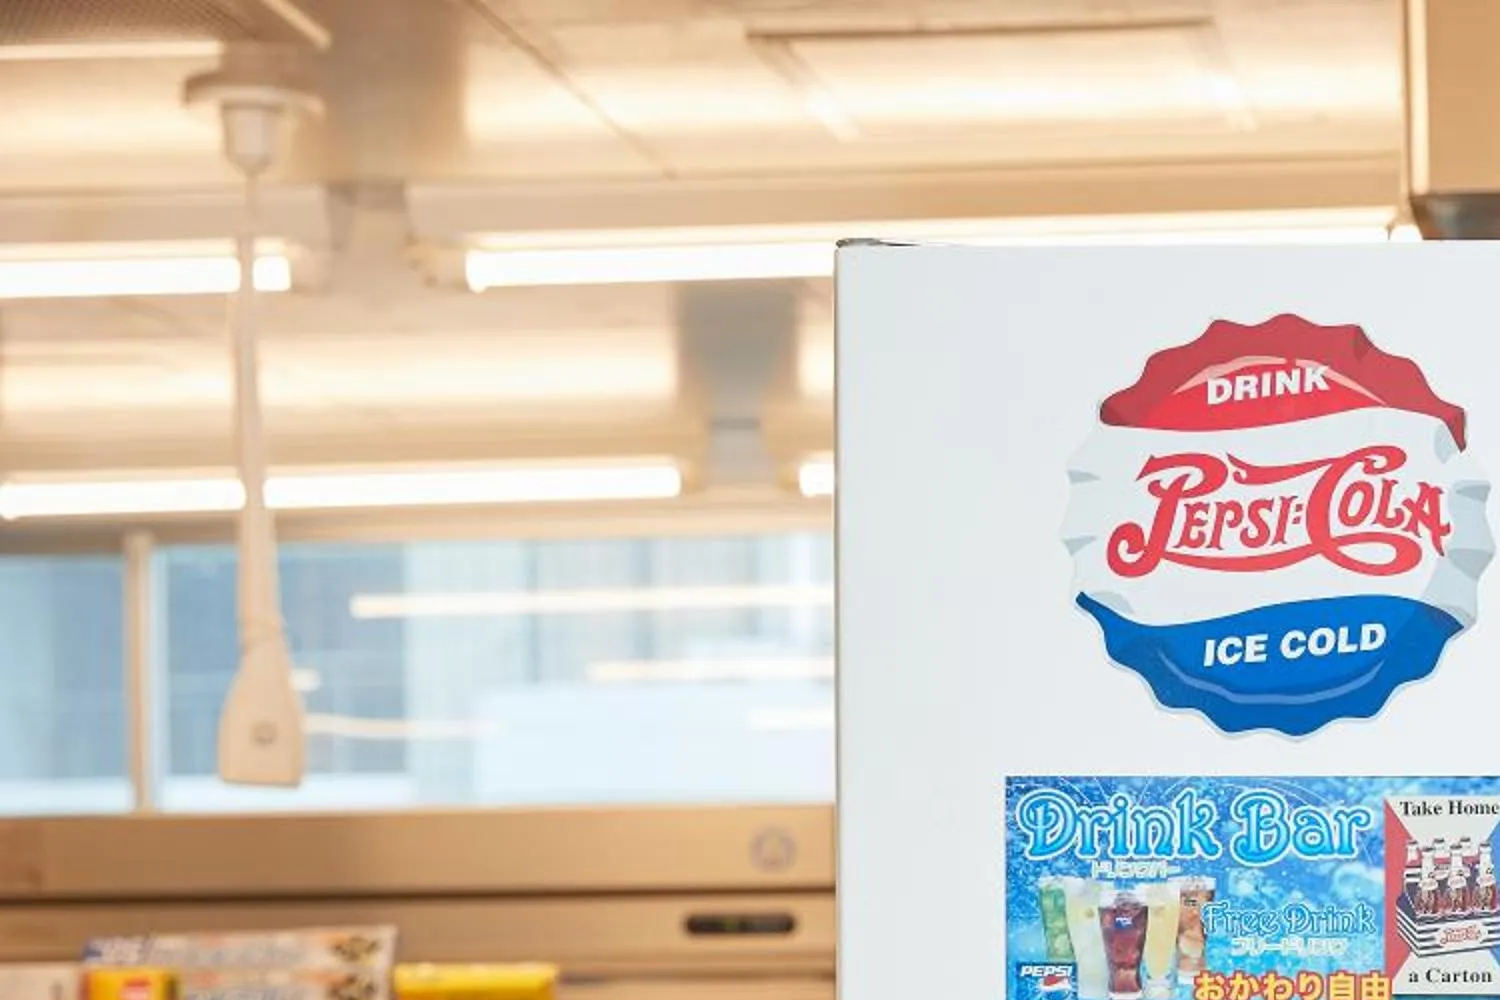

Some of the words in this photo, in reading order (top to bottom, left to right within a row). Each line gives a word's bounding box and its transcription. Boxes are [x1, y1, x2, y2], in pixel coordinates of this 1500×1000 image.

[1206, 366, 1330, 405] DRINK
[1203, 634, 1268, 667] ICE
[1280, 623, 1387, 659] COLD
[1400, 801, 1442, 816] Take
[1448, 800, 1500, 815] Home
[1016, 788, 1222, 861] Drink
[1231, 790, 1372, 867] Bar
[1202, 901, 1278, 938] Free
[1282, 901, 1376, 938] Drink
[1020, 965, 1073, 978] PEPSI
[1408, 972, 1420, 983] a
[1426, 968, 1493, 983] Carton
